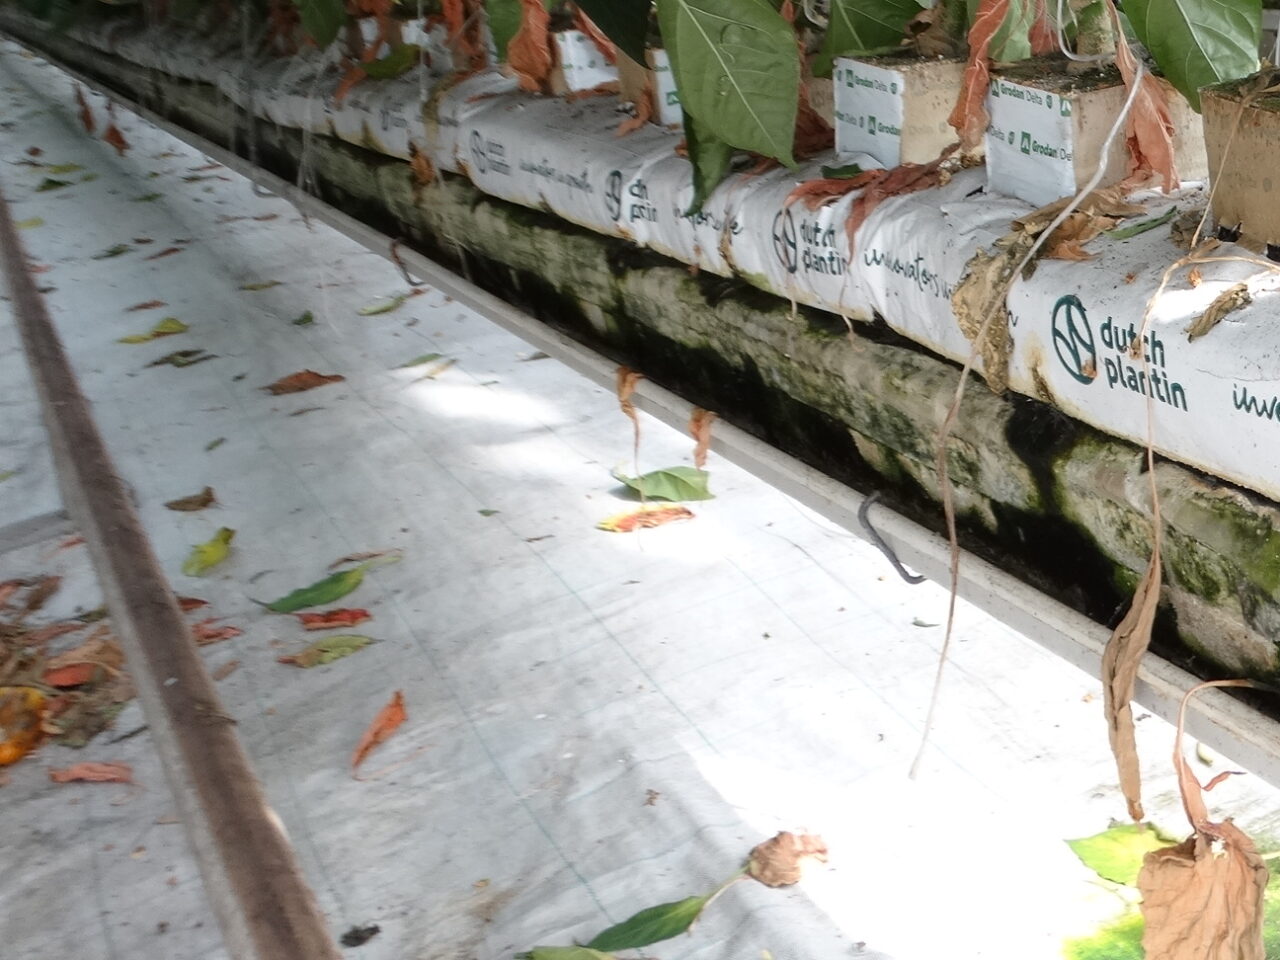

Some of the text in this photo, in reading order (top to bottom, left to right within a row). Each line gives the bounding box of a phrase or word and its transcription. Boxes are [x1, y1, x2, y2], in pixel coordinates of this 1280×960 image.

[1000, 83, 1025, 100] Grodan
[1031, 140, 1058, 159] Grodan
[1104, 354, 1189, 412] plantin
